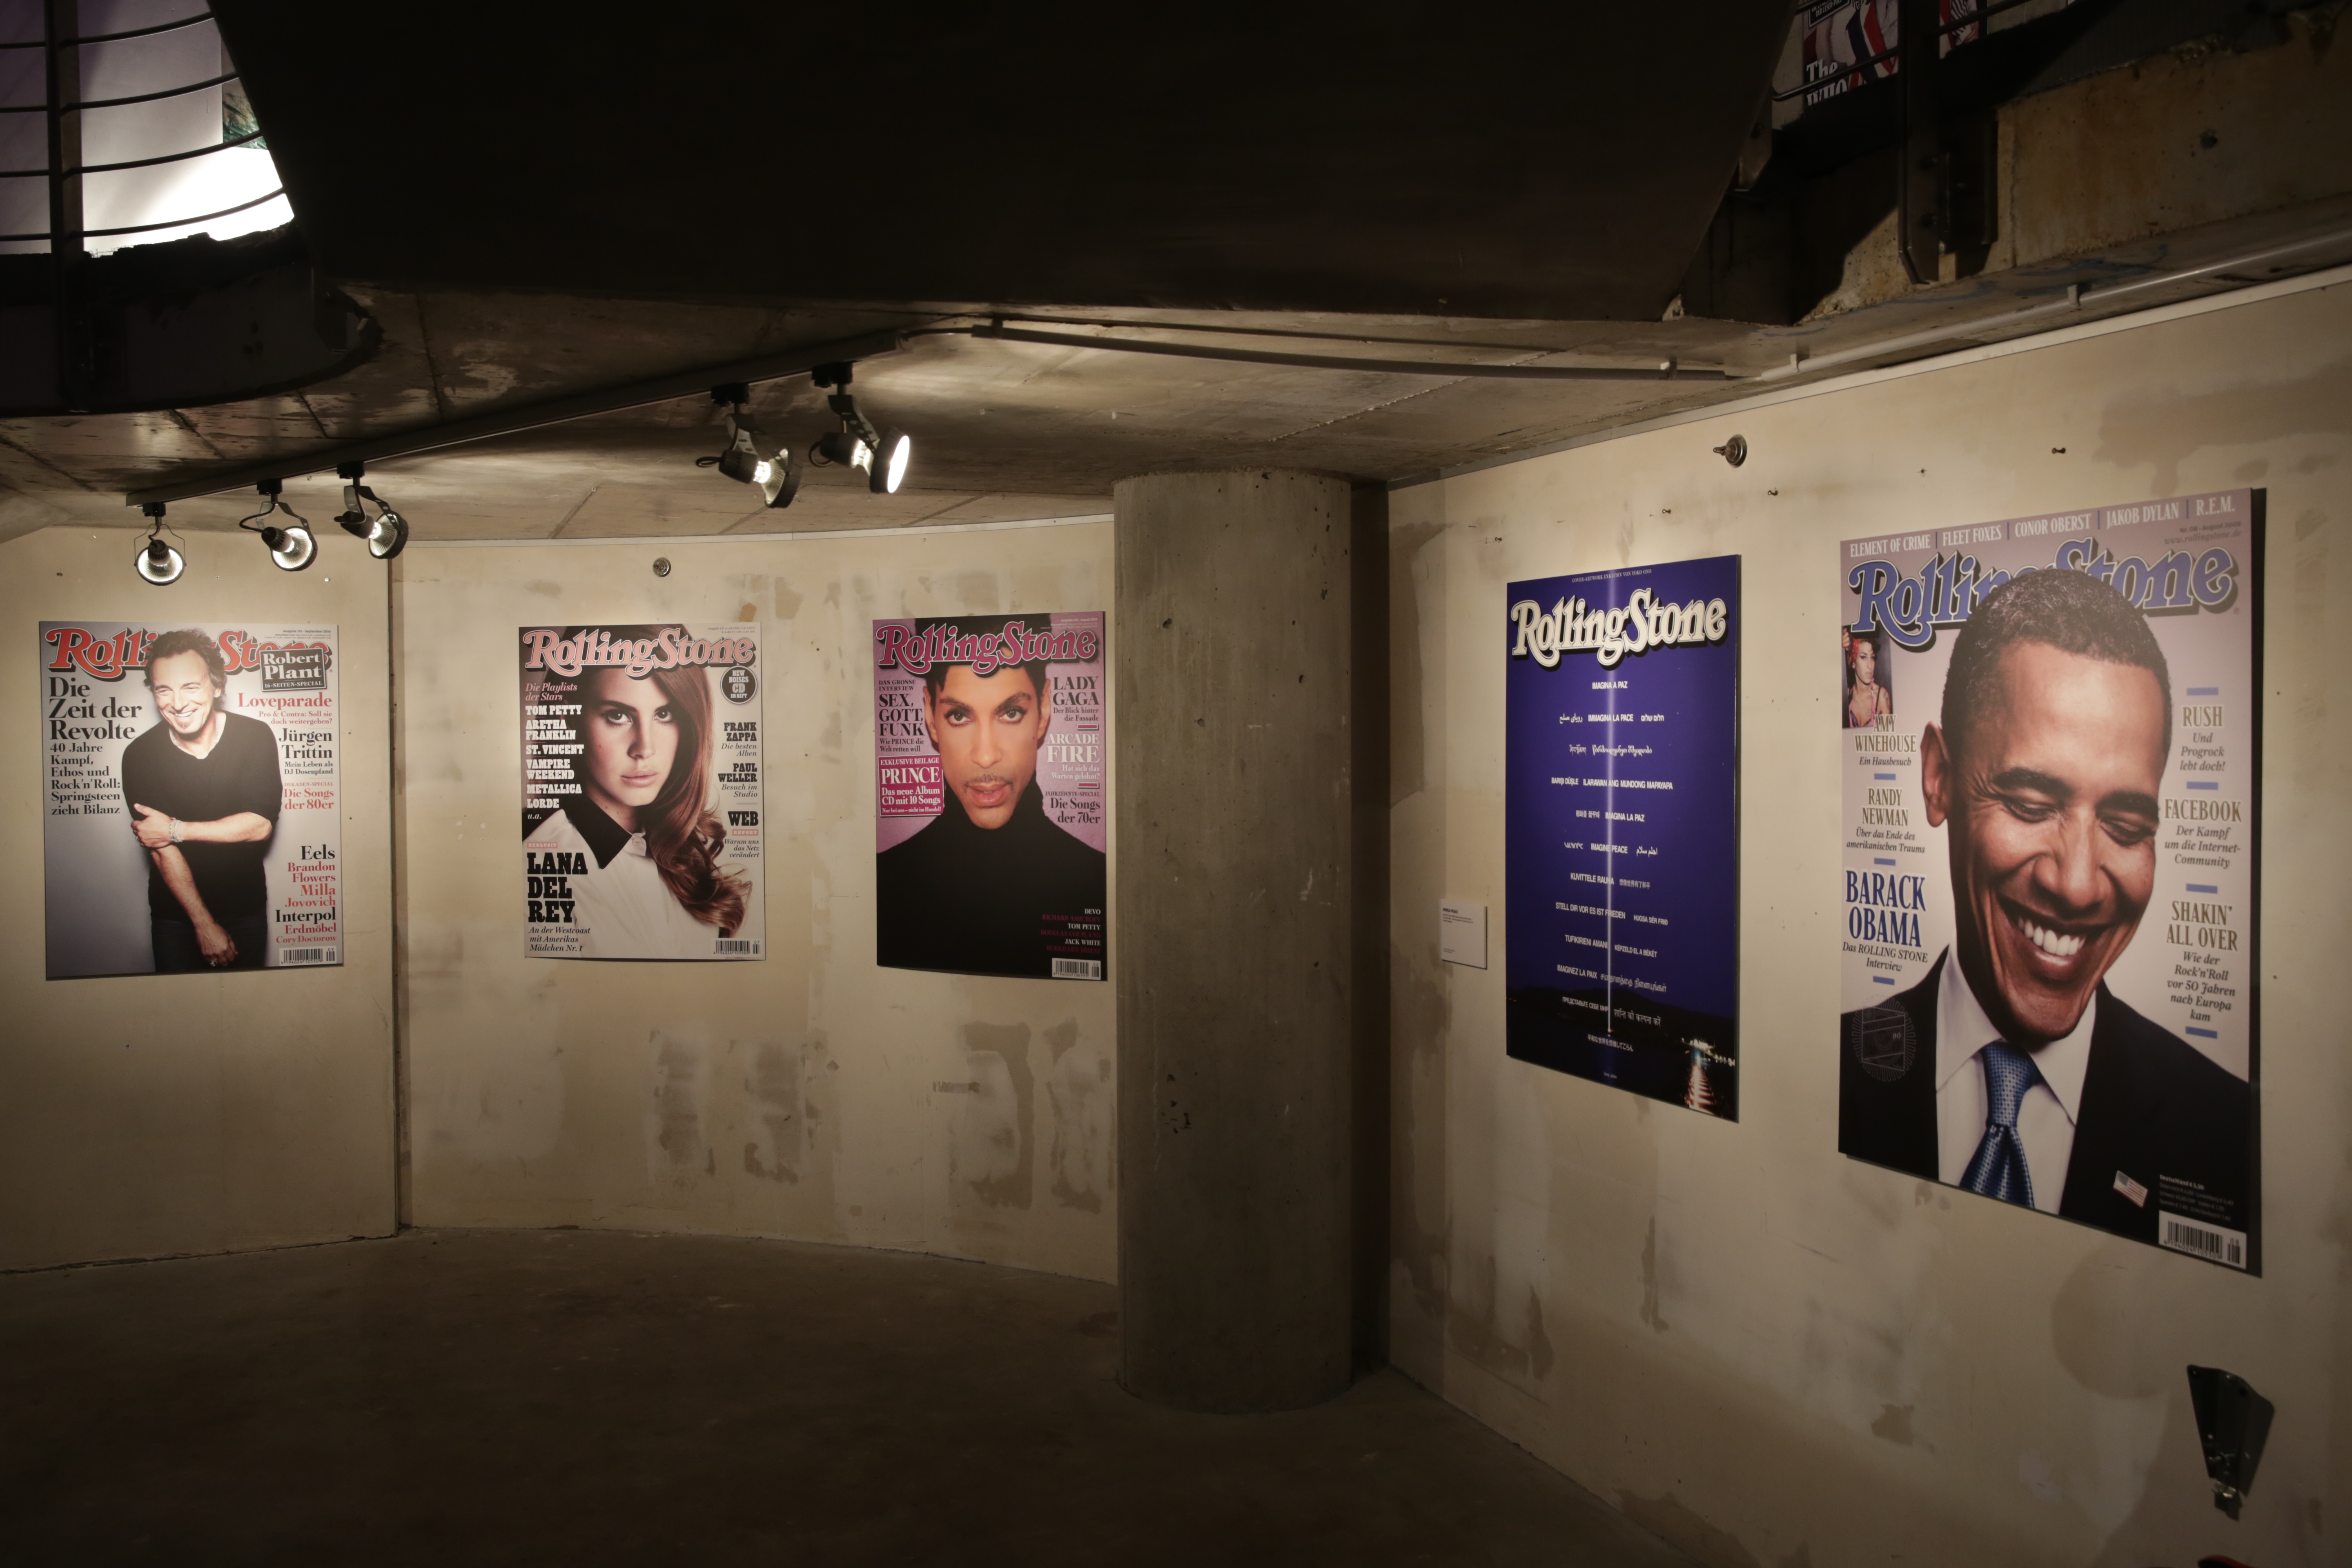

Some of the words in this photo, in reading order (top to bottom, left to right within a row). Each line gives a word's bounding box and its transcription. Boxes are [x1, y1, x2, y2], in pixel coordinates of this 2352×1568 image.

[2196, 496, 2235, 516] R.E.M.
[2106, 508, 2140, 529] JAKOB
[2143, 502, 2179, 522] DYLAN
[2015, 519, 2048, 537] CONOR
[2051, 513, 2091, 533] OBERST
[1942, 530, 1970, 546] FLEET
[1973, 525, 2002, 543] FOXES
[1850, 539, 1888, 557] ELEMENT
[1890, 538, 1901, 553] OF
[1903, 534, 1931, 551] CRIME
[1511, 595, 1630, 668] Rolling
[1622, 588, 1727, 653] Stone
[523, 628, 654, 677] Rolling
[653, 628, 755, 669] Stone
[876, 623, 1003, 675] Rolling
[999, 621, 1098, 666] Stone
[263, 652, 321, 664] Robert
[264, 665, 322, 679] Plant
[49, 677, 90, 697] Die
[525, 683, 540, 691] Die
[542, 682, 577, 693] Playlists
[732, 683, 746, 693] CD
[1053, 676, 1099, 690] LADY
[238, 692, 332, 710] Loveparade
[526, 692, 539, 701] der
[541, 693, 563, 701] Stars
[879, 694, 913, 707] SEX,
[1053, 691, 1100, 706] GAGA
[49, 699, 97, 718] Zeit
[102, 697, 142, 718] der
[879, 708, 923, 722] GOTT,
[1873, 715, 1896, 732] AMY
[2182, 706, 2223, 727] RUSH
[49, 720, 136, 739] Revolte
[724, 722, 757, 731] FRANK
[880, 723, 925, 736] FUNK
[279, 728, 332, 746] Jürgen
[726, 733, 757, 742] ZAPPA
[1047, 733, 1100, 744] ARCADE
[1854, 735, 1917, 753] WINEHOUSE
[50, 743, 66, 753] 40
[69, 742, 103, 752] Jahre
[282, 745, 333, 758] Trittin
[1047, 745, 1100, 763] FIRE
[51, 754, 94, 767] Kampf,
[526, 759, 570, 769] VAMPIRE
[733, 763, 757, 772] PAUL
[2180, 760, 2197, 771] lebt
[526, 769, 575, 780] WEEKEND
[718, 773, 757, 782] WELLER
[881, 767, 940, 784] PRINCE
[51, 778, 120, 789] Rock'n'Roll:
[527, 784, 582, 794] METALLICA
[882, 787, 895, 795] Das
[915, 785, 940, 795] Album
[51, 791, 120, 804] Springsteen
[527, 798, 559, 808] LORDE
[882, 796, 895, 805] CD
[896, 796, 908, 804] mit
[910, 795, 917, 804] 10
[919, 795, 941, 805] Songs
[1868, 788, 1902, 806] RANDY
[51, 804, 80, 815] zieht
[84, 804, 120, 814] Bilanz
[1862, 807, 1909, 826] NEWMAN
[2164, 799, 2242, 822] FACEBOOK
[728, 811, 759, 826] WEB
[301, 844, 335, 860] Eels
[1591, 843, 1610, 852] IMAGINE
[1611, 845, 1628, 854] PEACE
[1899, 843, 1925, 853] Traums
[288, 861, 335, 872] Brandon
[527, 853, 588, 875] LANA
[2175, 853, 2230, 869] Community
[292, 872, 336, 882] Flowers
[1570, 873, 1596, 883] KUVITTELE
[1597, 875, 1615, 885] RAUHA
[300, 883, 336, 896] Milla
[527, 877, 572, 898] DEL
[1846, 870, 1926, 912] BARACK
[285, 895, 336, 907] Jovovich
[275, 906, 336, 924] Interpol
[528, 900, 575, 923] REY
[1556, 902, 1570, 911] STELL
[1605, 909, 1626, 919] FRIEDEN
[2172, 900, 2232, 926] SHAKIN'
[285, 922, 336, 934] Erdmöbel
[1849, 906, 1922, 948] OBAMA
[2166, 924, 2193, 946] ALL
[2198, 927, 2238, 952] OVER
[1842, 942, 1856, 952] Das
[1858, 944, 1896, 958] ROLLING
[1898, 949, 1928, 963] STONE
[1557, 964, 1579, 976] IMAGINEZ
[1579, 969, 1586, 977] LA
[1587, 970, 1597, 979] PAIX
